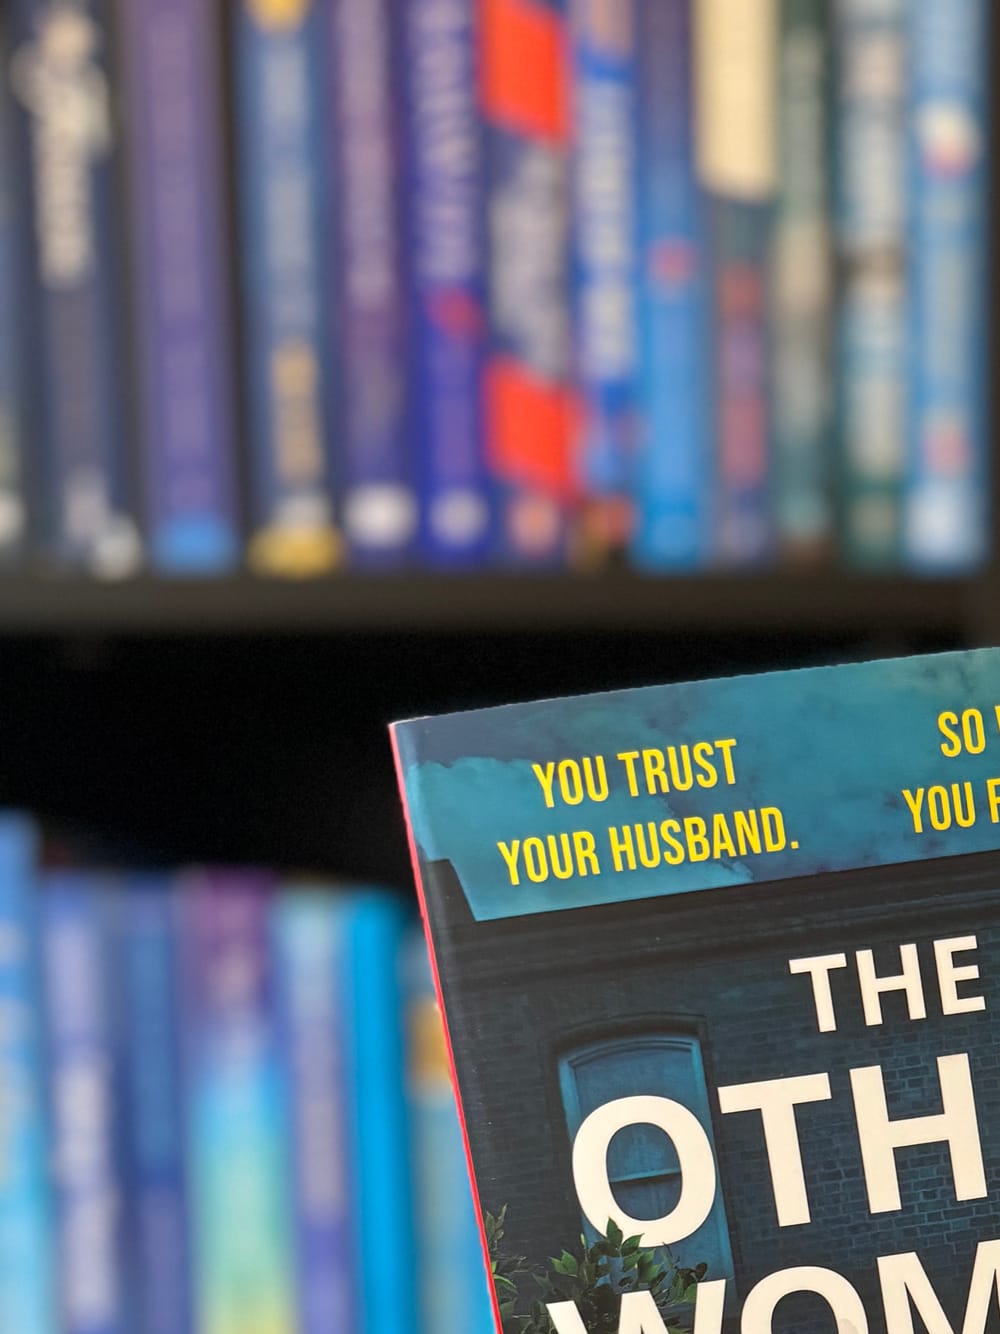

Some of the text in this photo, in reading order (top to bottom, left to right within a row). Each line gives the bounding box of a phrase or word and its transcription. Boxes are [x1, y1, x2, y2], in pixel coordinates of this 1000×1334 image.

[937, 709, 986, 757] SO
[532, 738, 737, 807] YOU TRUST
[902, 781, 976, 834] YOU
[497, 806, 799, 886] YOUR HUSBAND.
[788, 934, 987, 1033] THE
